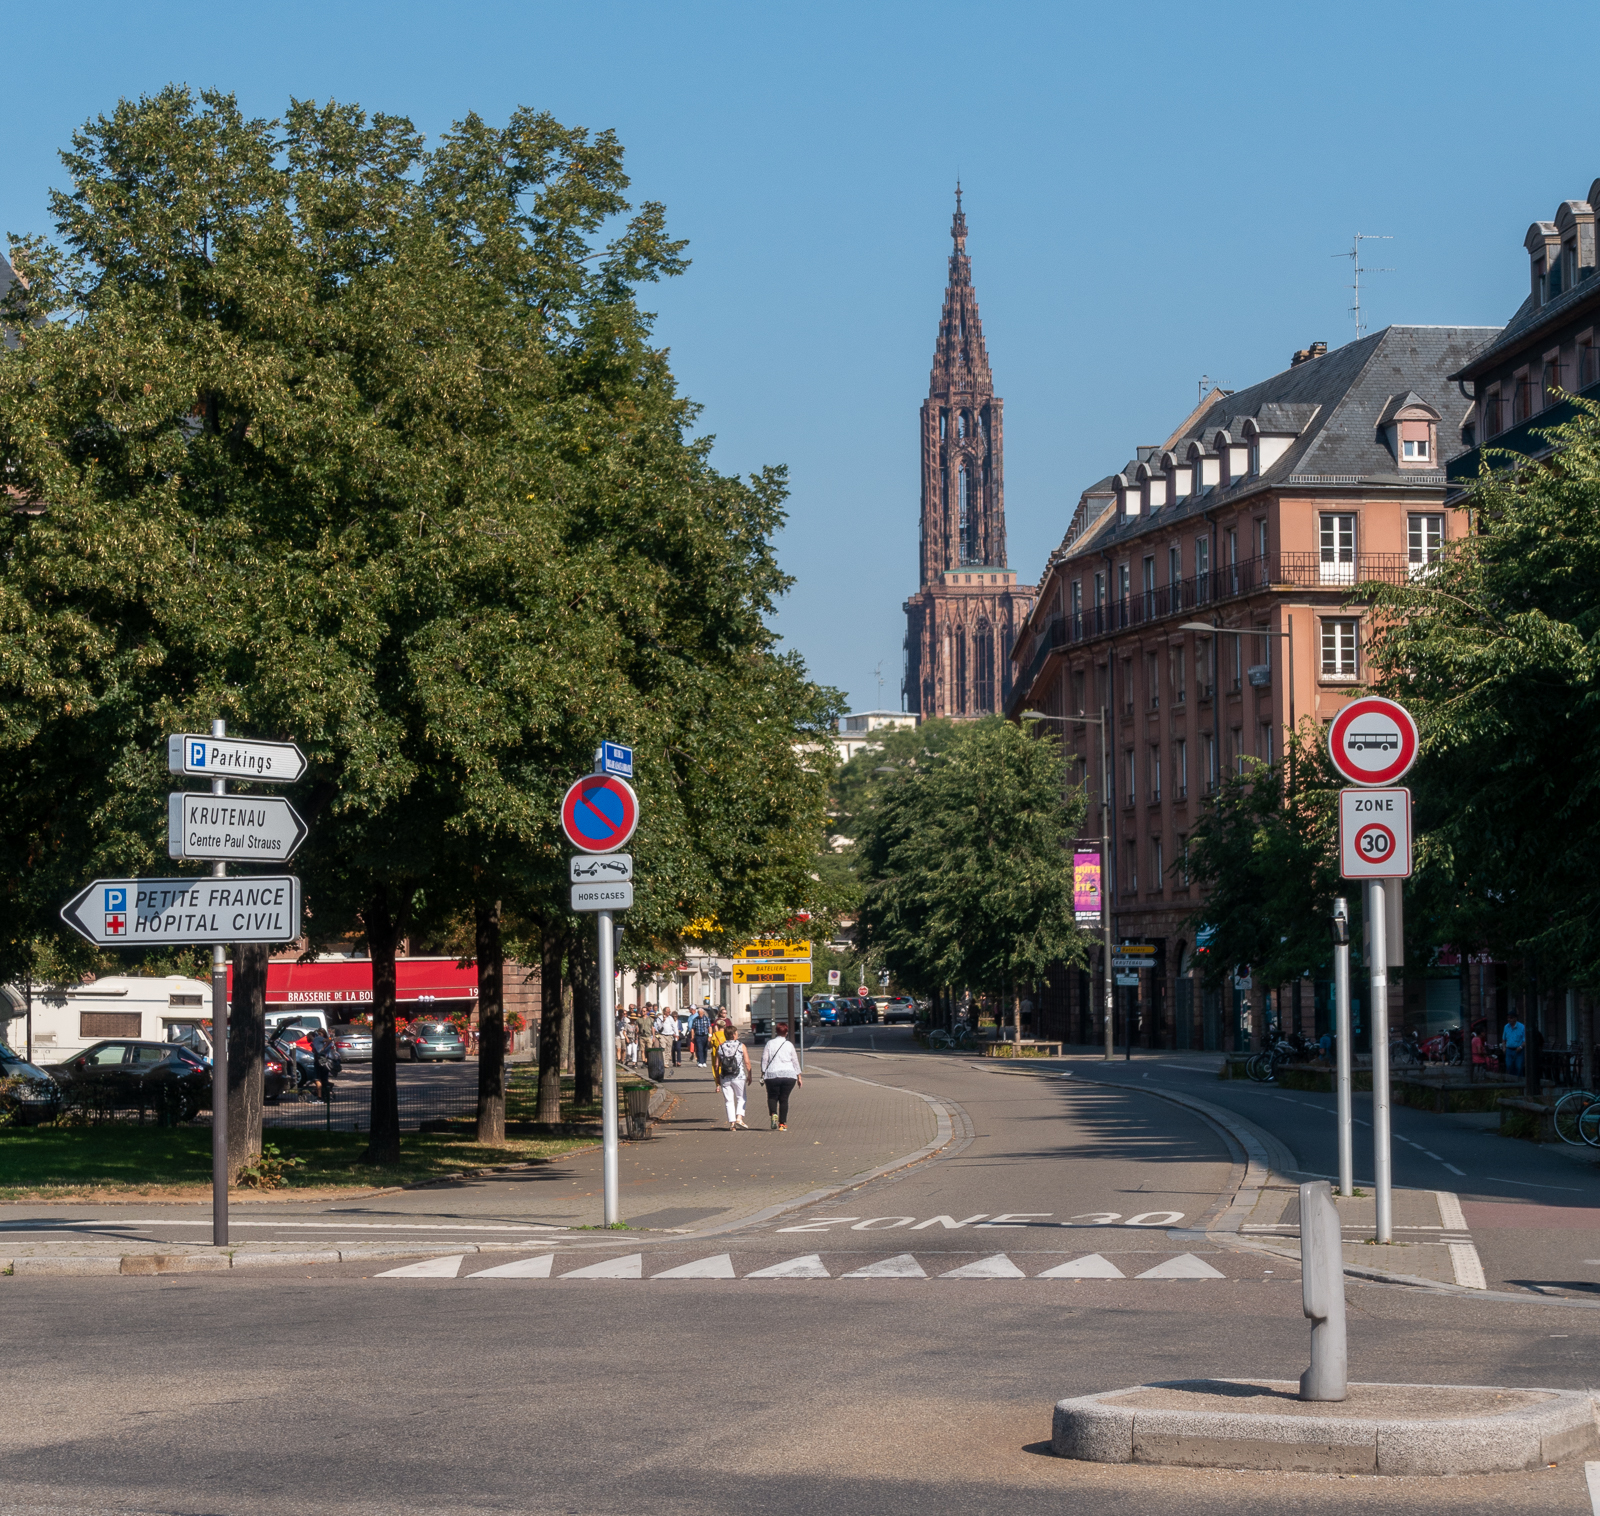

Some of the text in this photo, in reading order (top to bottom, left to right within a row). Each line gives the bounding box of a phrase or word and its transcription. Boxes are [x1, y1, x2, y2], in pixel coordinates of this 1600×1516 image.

[193, 744, 272, 774] P Parkings
[1355, 799, 1394, 811] ZONE
[190, 806, 266, 827] KRUTENAU
[190, 832, 282, 850] Centre Paul Strauss
[1362, 834, 1389, 853] 30
[1075, 865, 1101, 874] NUITS
[108, 888, 285, 910] P PETITE FRANCE
[578, 891, 625, 901] HORS CASES
[134, 911, 283, 933] HÔPITAL CIVIL
[757, 949, 774, 957] 180
[288, 992, 331, 1002] BRASSERIE
[334, 991, 342, 1000] DE
[346, 992, 357, 1001] LA
[774, 1211, 1186, 1233] ZONE 30
